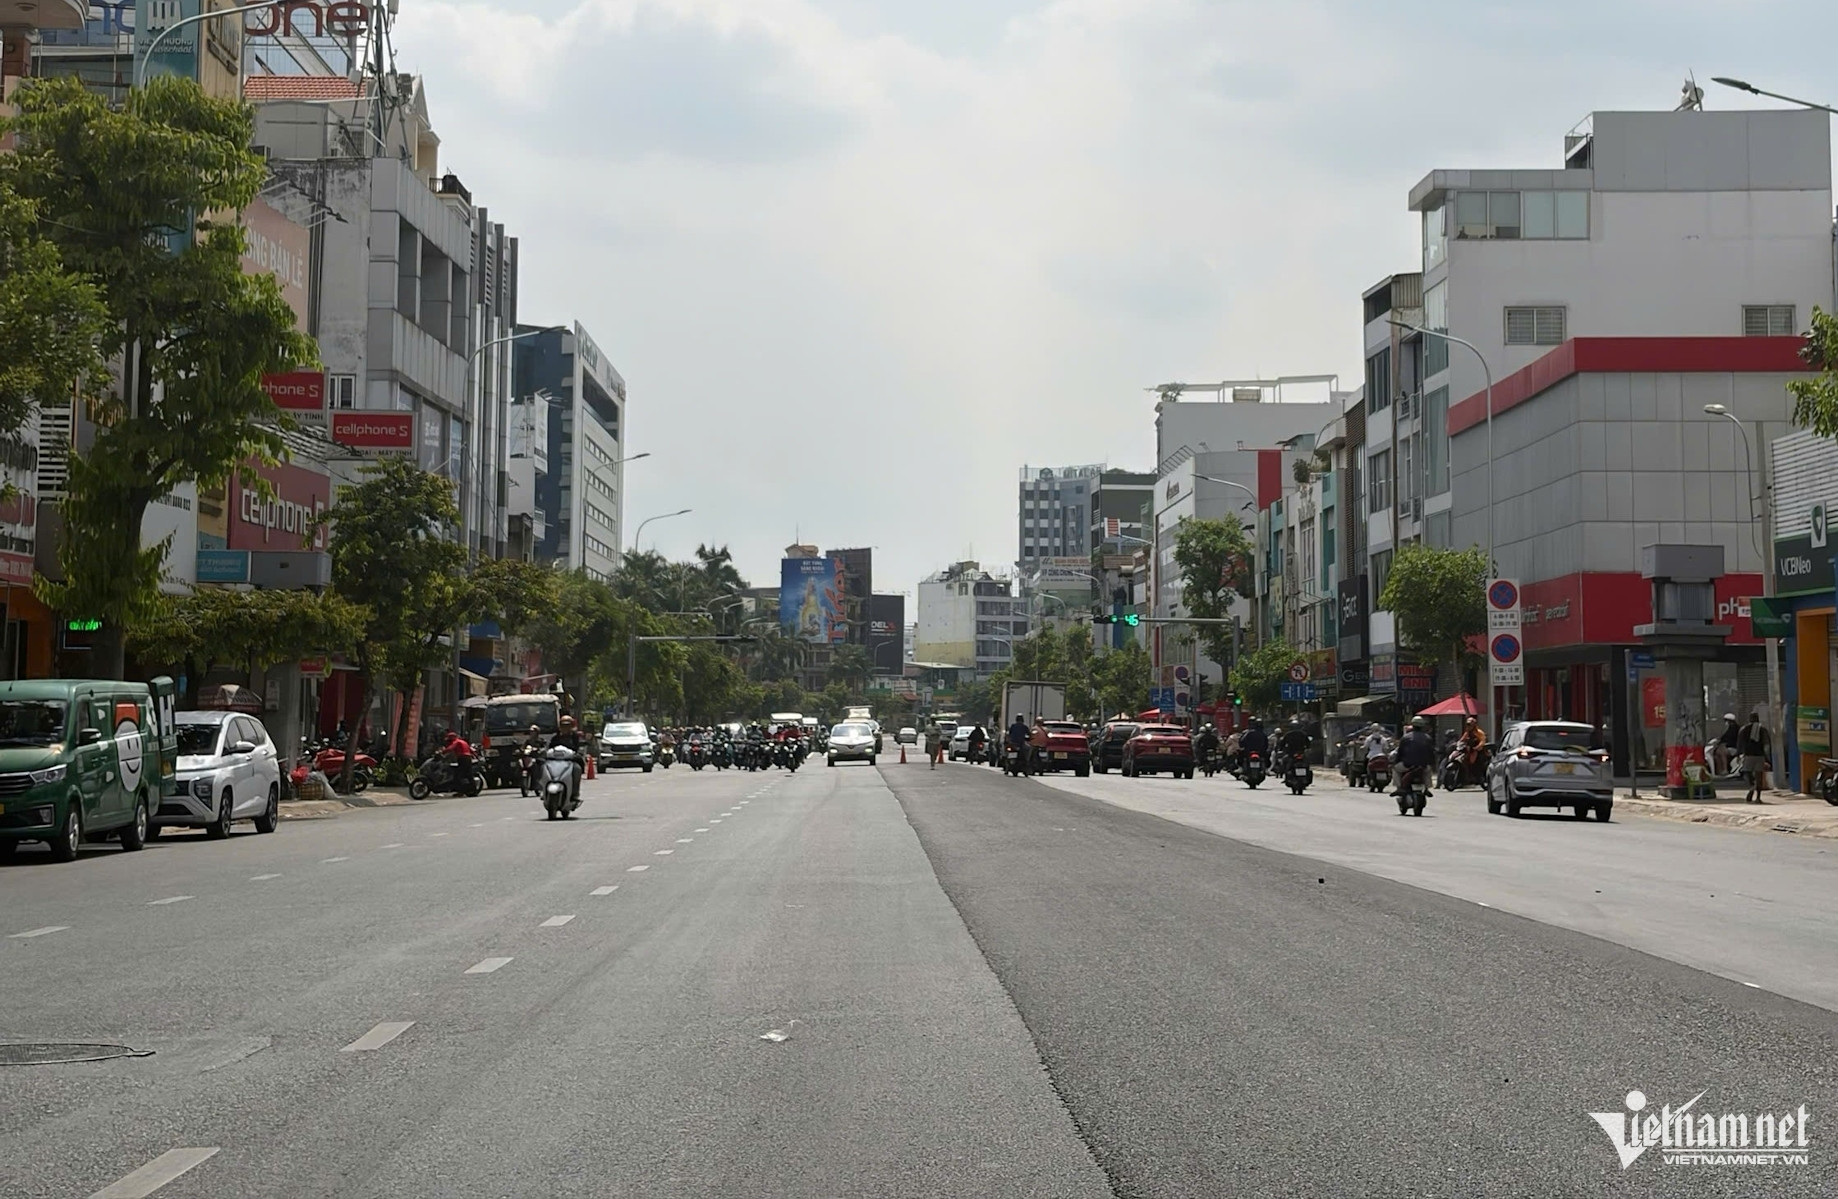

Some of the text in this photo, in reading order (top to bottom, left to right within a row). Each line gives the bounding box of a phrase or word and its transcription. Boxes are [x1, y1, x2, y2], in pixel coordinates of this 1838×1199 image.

[270, 240, 290, 281] BÁN
[309, 385, 319, 398] S
[336, 425, 408, 437] cellphone S
[242, 482, 313, 543] cellphone
[1780, 556, 1811, 576] VCBNeo
[1124, 614, 1139, 626] 46
